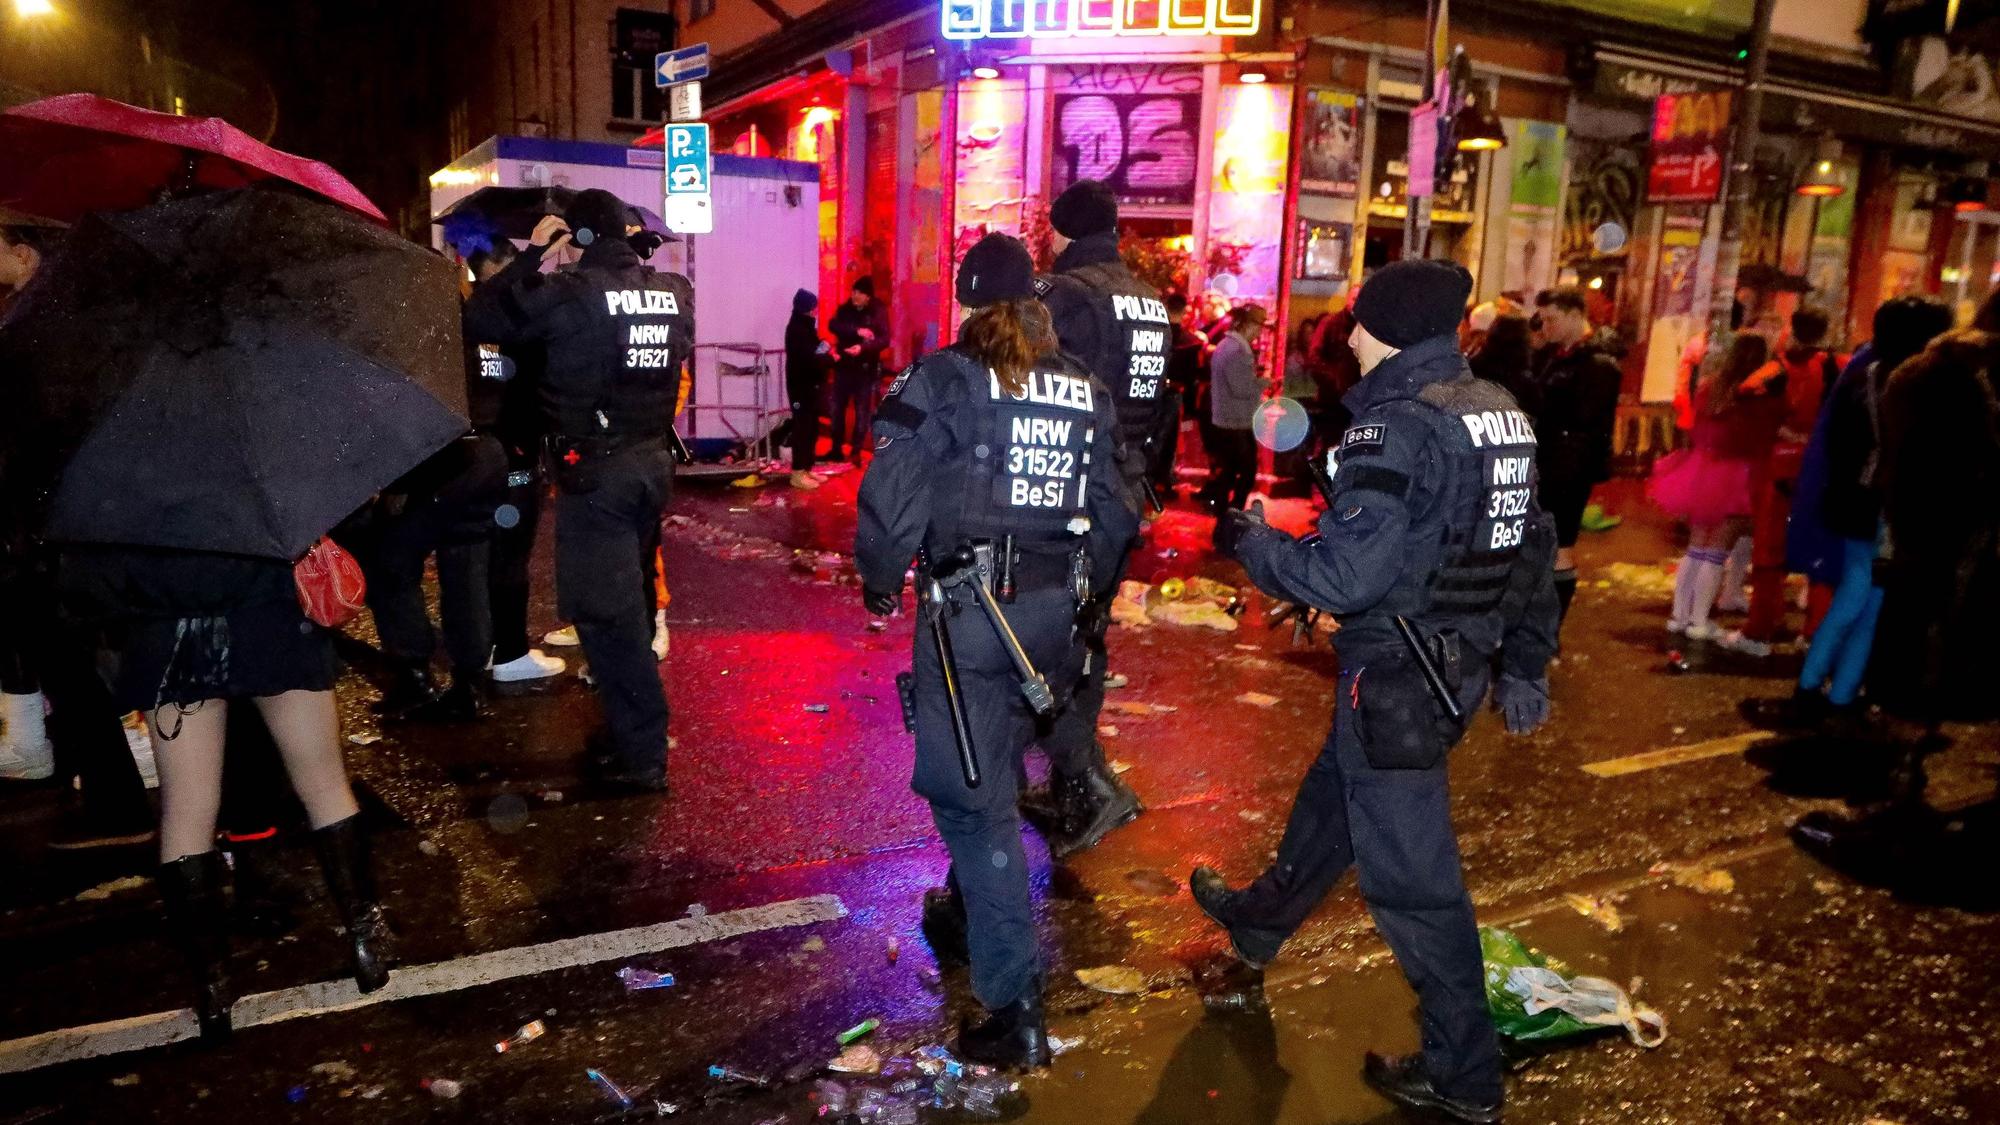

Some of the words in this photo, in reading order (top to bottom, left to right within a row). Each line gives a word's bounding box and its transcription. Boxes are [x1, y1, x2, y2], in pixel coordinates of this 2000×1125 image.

[672, 128, 691, 158] P
[605, 290, 679, 315] POLIZEI
[629, 325, 669, 344] NRW
[1131, 330, 1163, 352] NRW
[480, 360, 502, 377] 31521
[626, 348, 669, 367] 31521
[1129, 355, 1165, 376] 31523
[1129, 378, 1158, 398] BeSi
[1012, 417, 1072, 446] NRW
[1348, 428, 1379, 443] BeSi
[1008, 446, 1074, 478] 31522
[1493, 457, 1530, 485] NRW
[1011, 479, 1065, 507] BeSi
[1488, 488, 1531, 518] 31522
[1490, 519, 1525, 549] BeSi
